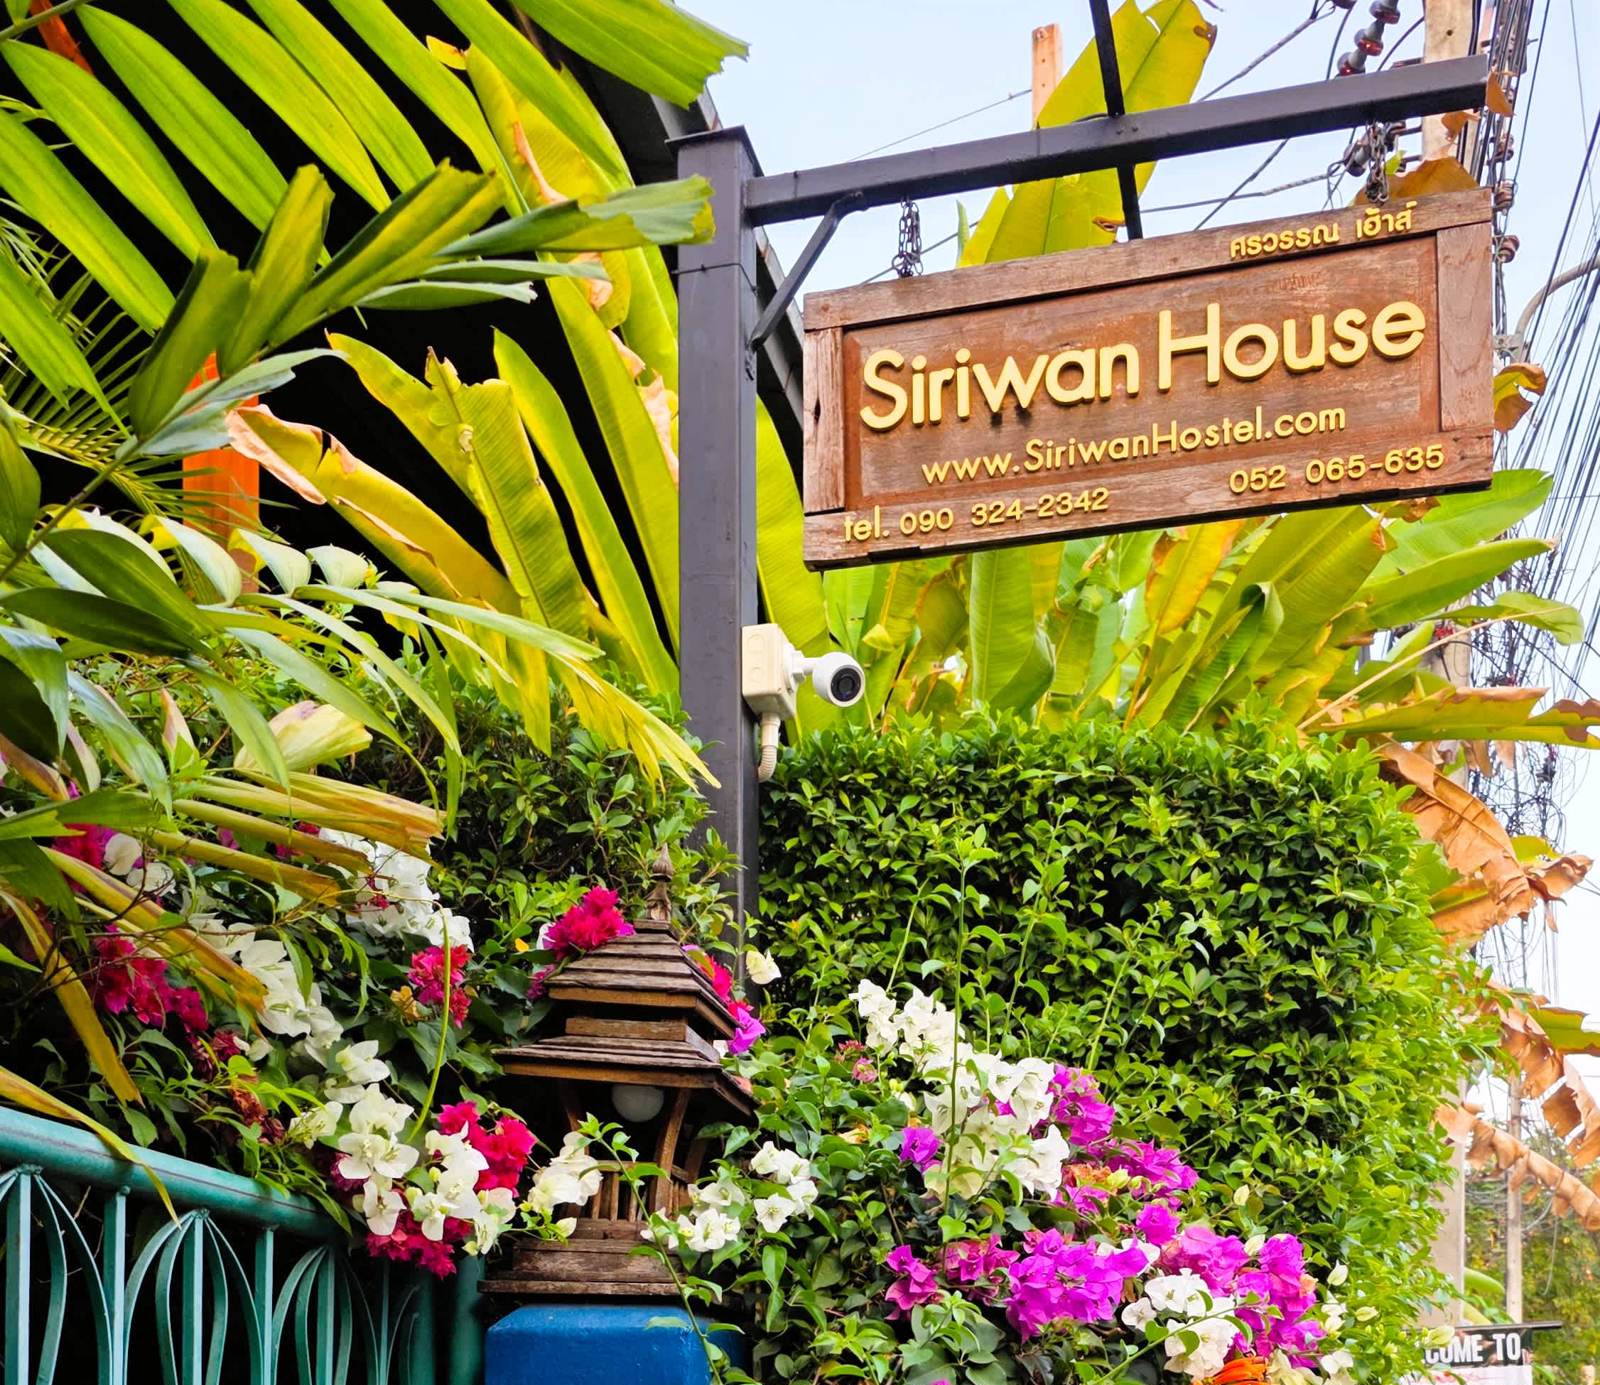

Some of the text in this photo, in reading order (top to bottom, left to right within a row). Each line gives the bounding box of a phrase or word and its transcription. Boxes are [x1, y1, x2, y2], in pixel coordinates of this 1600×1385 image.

[859, 300, 1427, 432] Siriwan House
[920, 407, 1346, 484] www.SiriwanHostel.com
[1229, 443, 1445, 493] 052 065-635
[844, 487, 1110, 541] tel. 090 324-2342
[1492, 1332, 1522, 1362] TO
